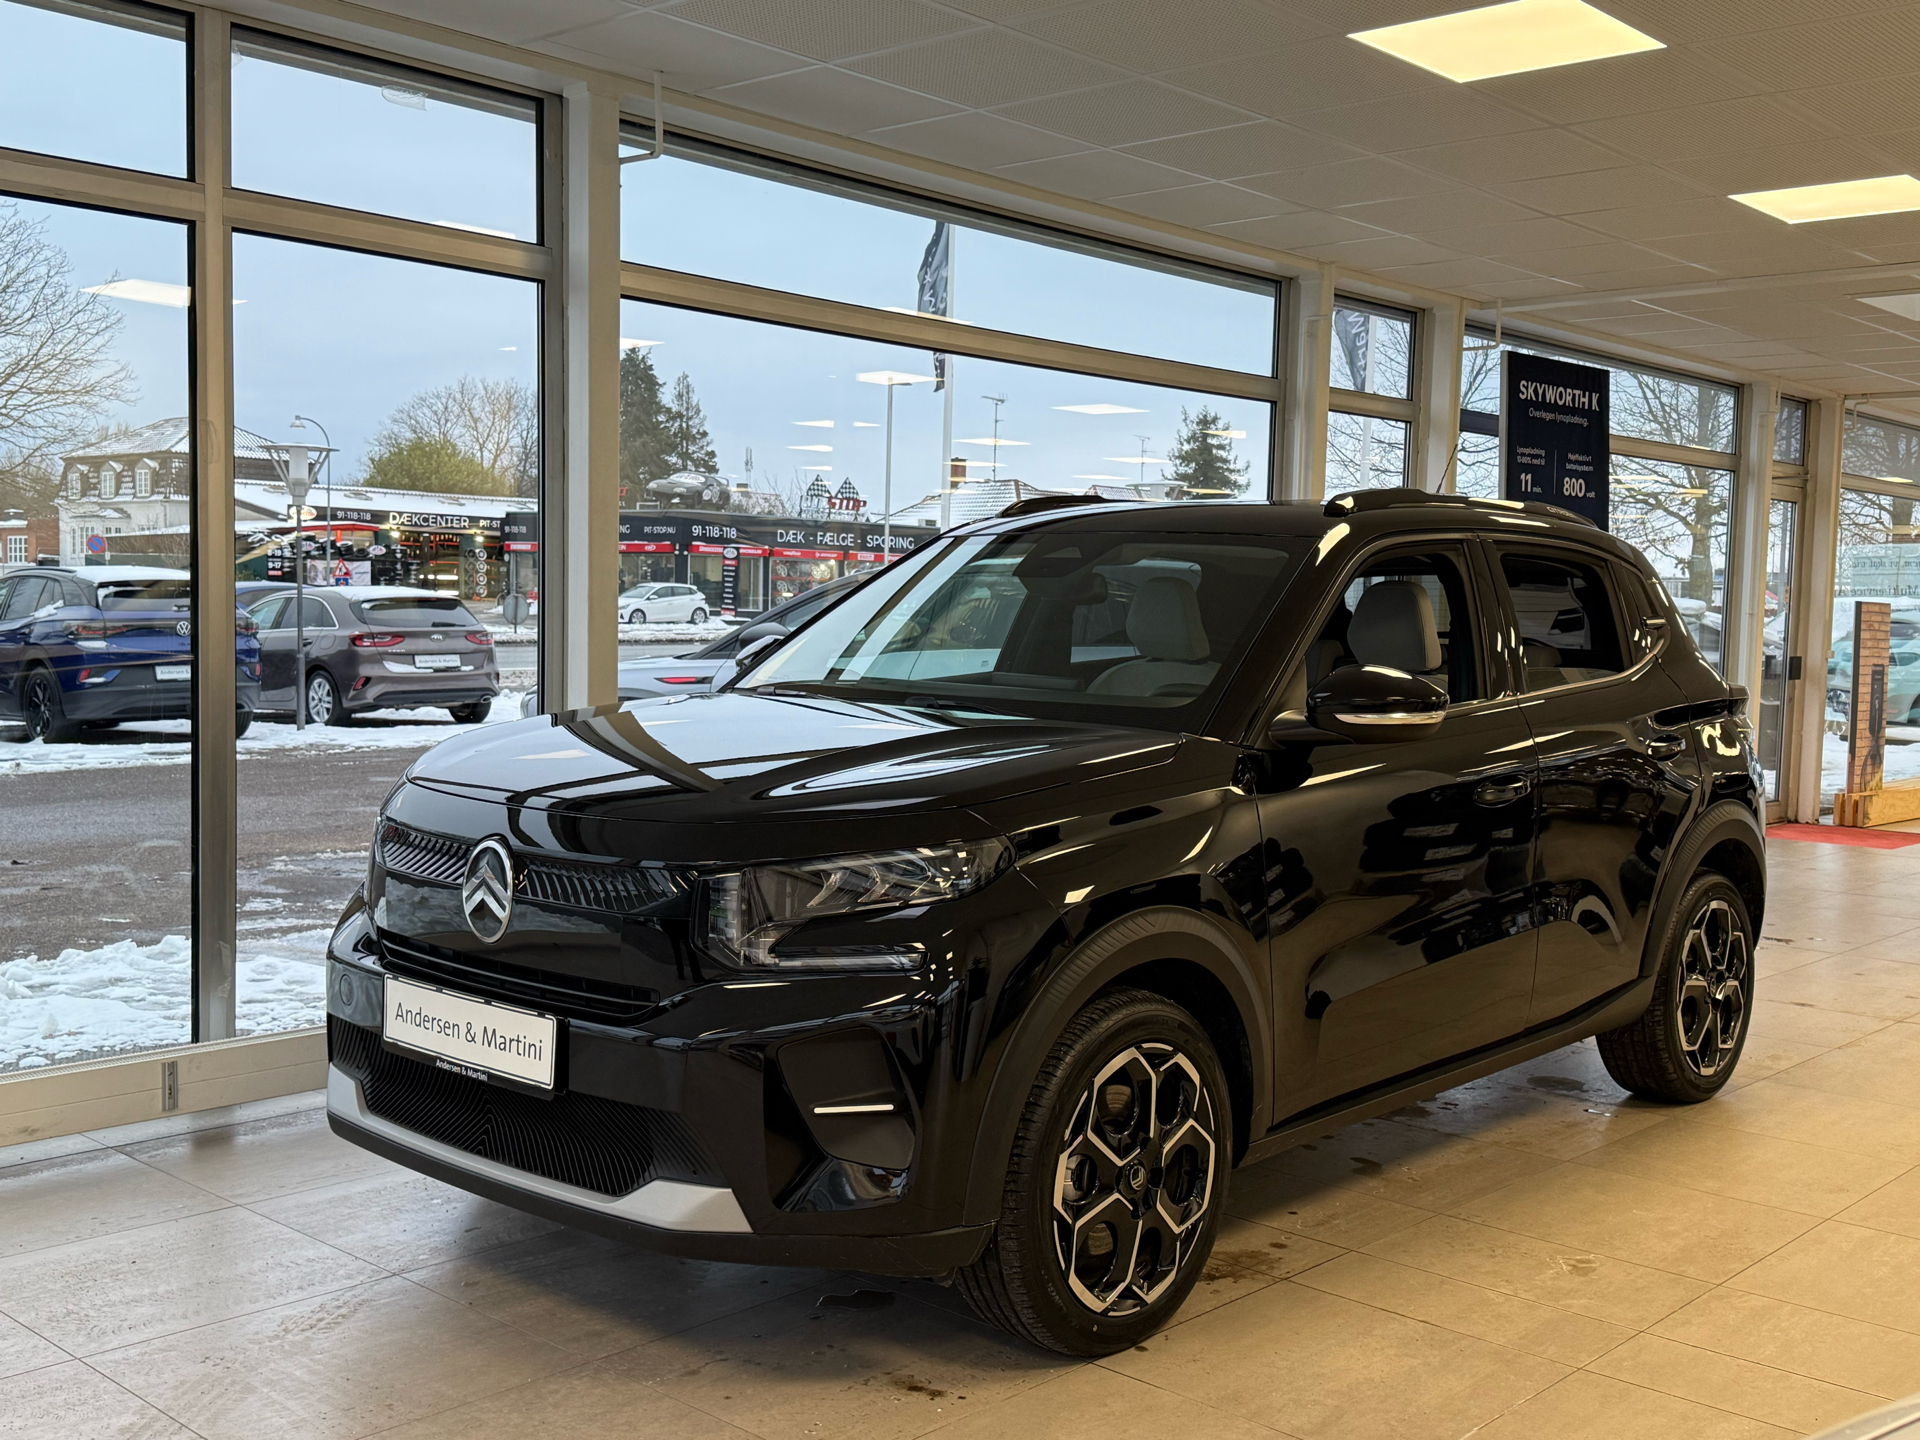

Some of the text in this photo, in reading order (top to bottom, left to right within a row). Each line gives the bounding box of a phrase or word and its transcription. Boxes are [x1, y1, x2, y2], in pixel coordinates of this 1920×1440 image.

[1519, 380, 1600, 411] SKYWORTH K
[1529, 407, 1555, 421] Overlegen
[1520, 472, 1532, 492] 11
[1563, 477, 1586, 498] 800
[336, 511, 371, 520] 91-118-118
[389, 512, 469, 528] DÆKCENTER
[692, 525, 737, 539] 91-118-118
[777, 530, 805, 543] DÆK
[817, 532, 854, 546] FÆLGE
[395, 1002, 543, 1062] Andersen & Martini
[436, 1059, 488, 1082] Andersen & Martini
